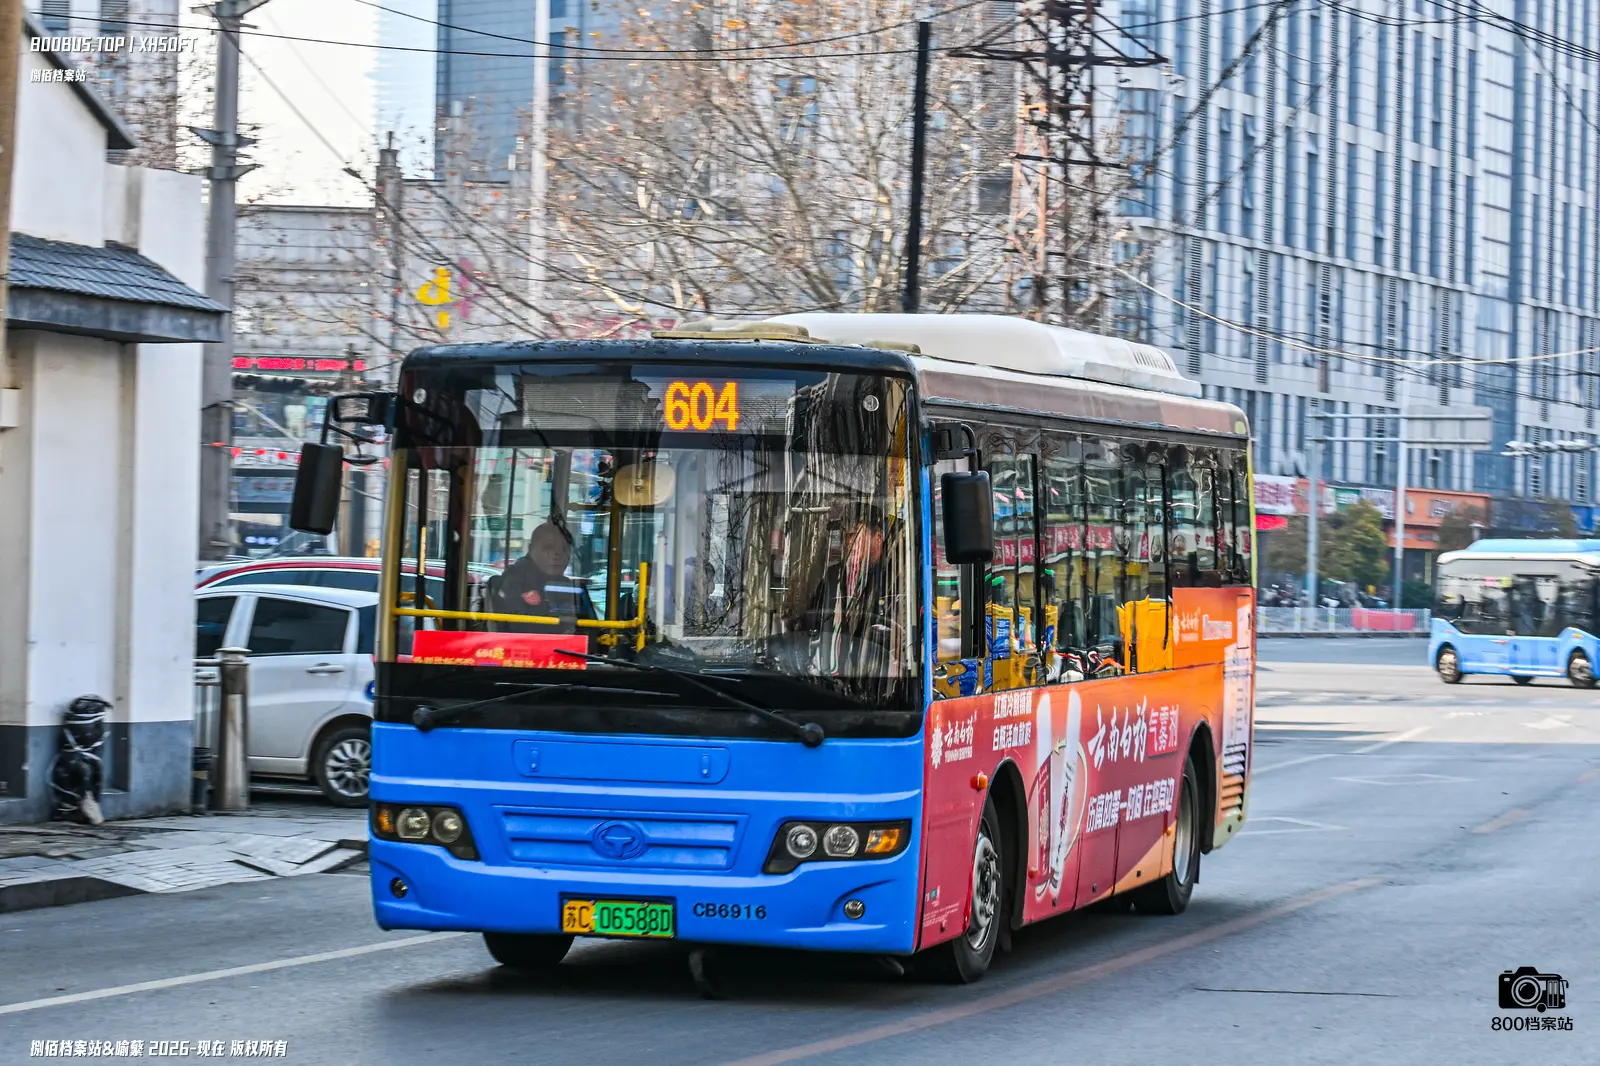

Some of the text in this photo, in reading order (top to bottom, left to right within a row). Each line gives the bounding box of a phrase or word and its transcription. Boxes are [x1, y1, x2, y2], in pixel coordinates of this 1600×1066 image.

[664, 381, 739, 431] 604
[944, 714, 974, 748] 云南白药
[1087, 695, 1179, 772] 云南白药 气雾剂
[693, 902, 767, 920] CB6916
